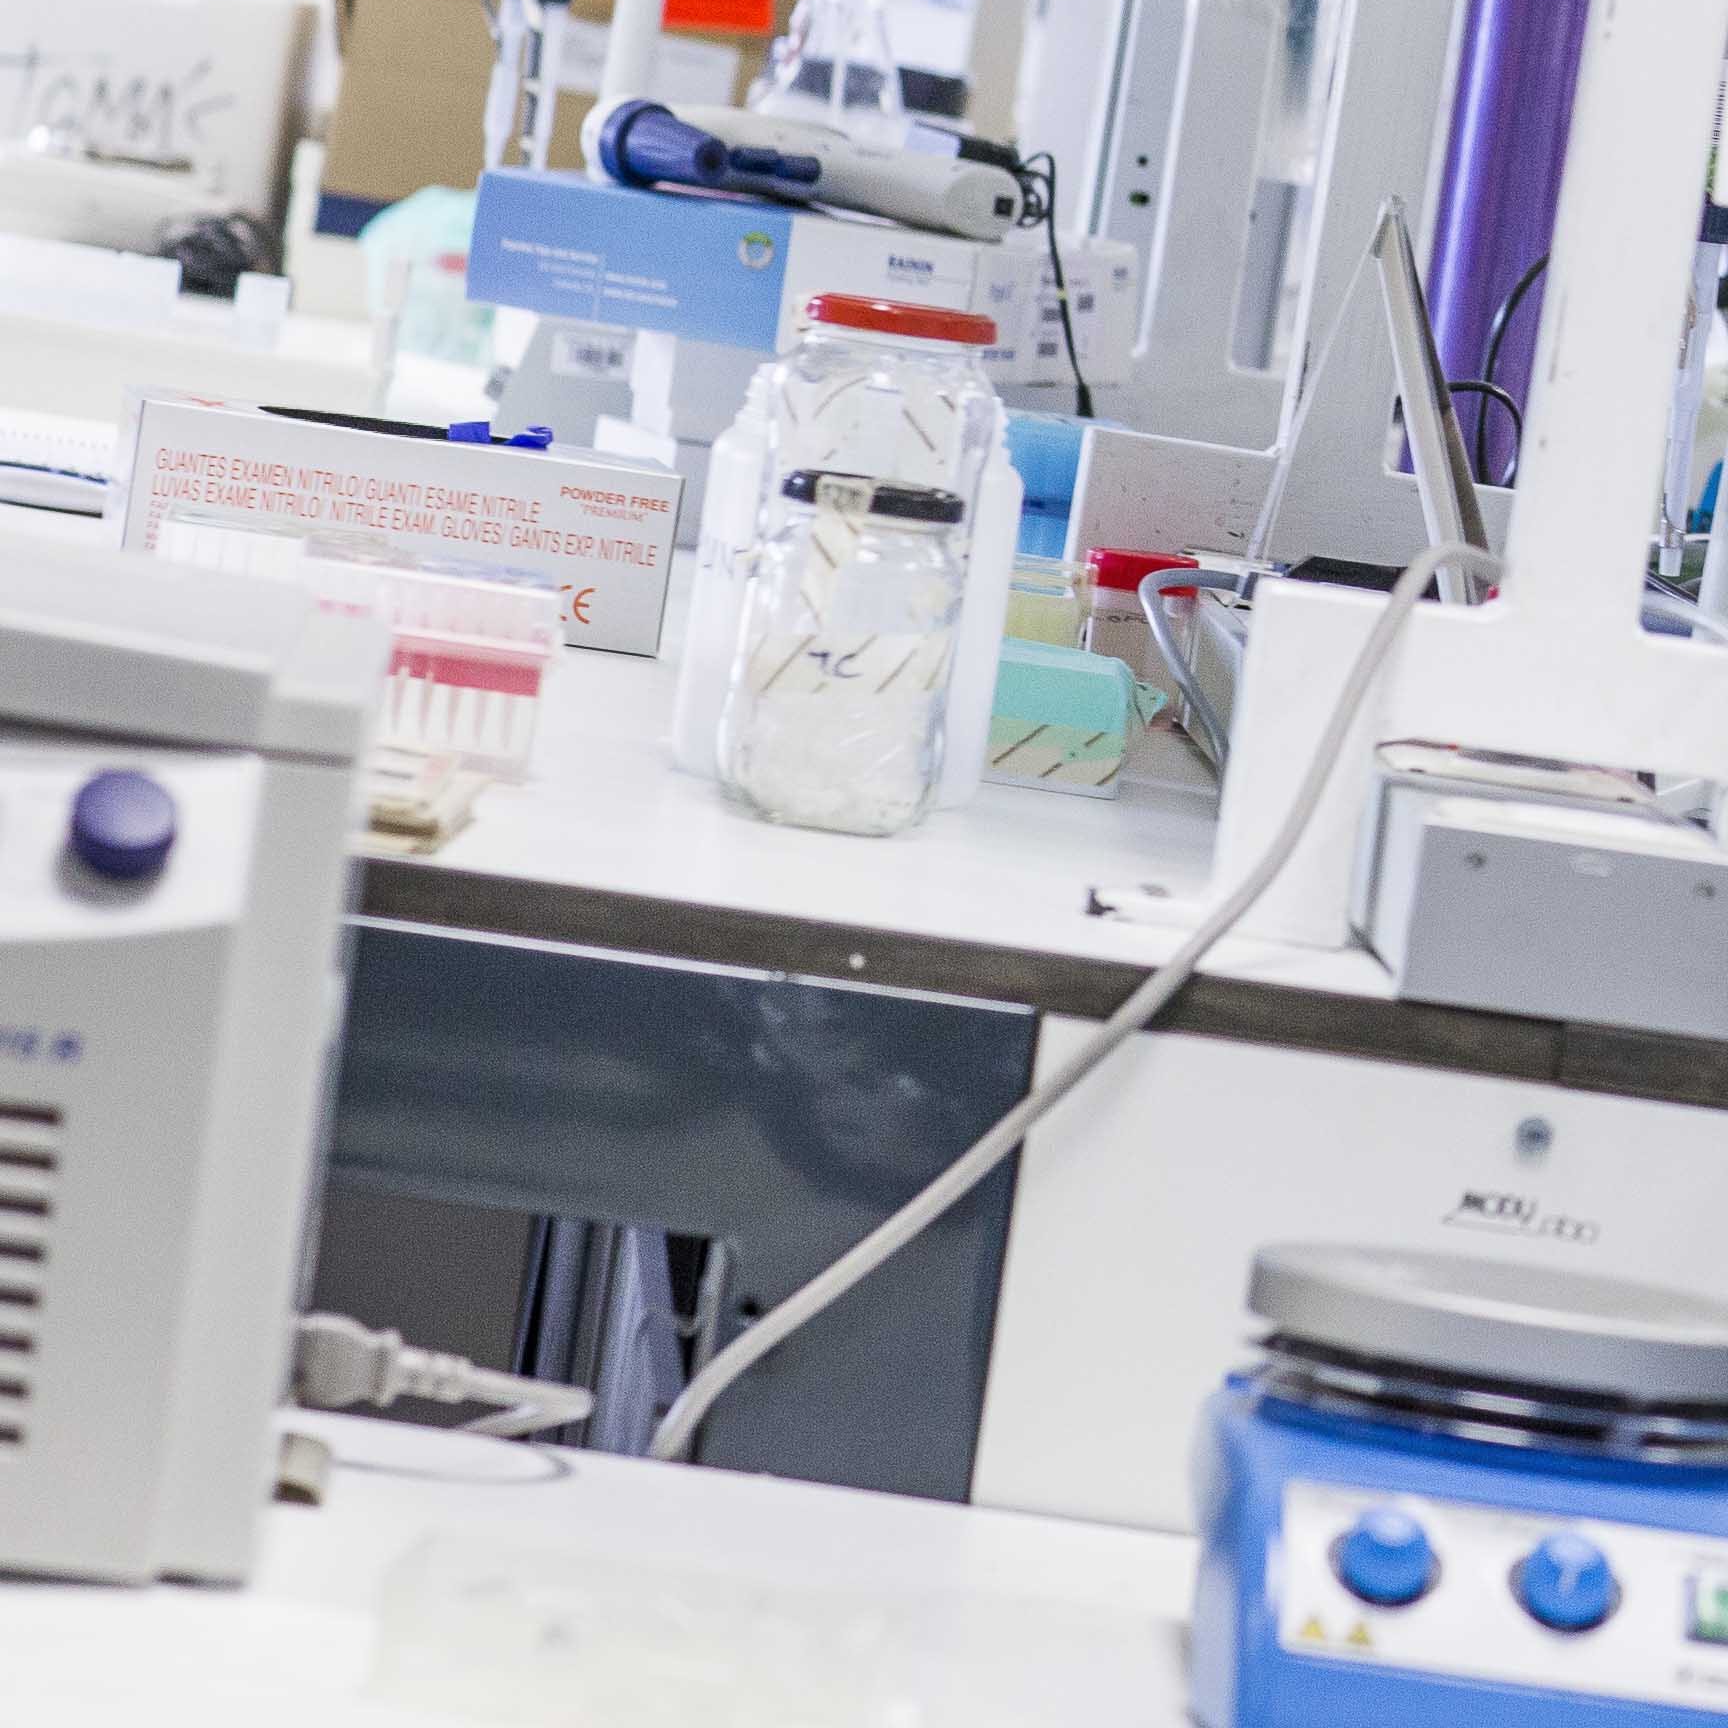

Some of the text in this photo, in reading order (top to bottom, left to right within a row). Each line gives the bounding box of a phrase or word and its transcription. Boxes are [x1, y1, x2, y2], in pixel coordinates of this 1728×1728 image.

[151, 473, 201, 502] LUVAS
[204, 481, 258, 510] EXAME
[331, 499, 390, 529] NITRILE
[509, 524, 562, 555] GANTS
[600, 538, 659, 568] NITRILE
[155, 447, 227, 479] GUANTES
[231, 458, 292, 488] EXAMEN
[366, 478, 421, 504] GUANTI
[425, 485, 480, 515] ESAME
[483, 495, 542, 524] NITRILE
[560, 485, 670, 514] POWDER FREE
